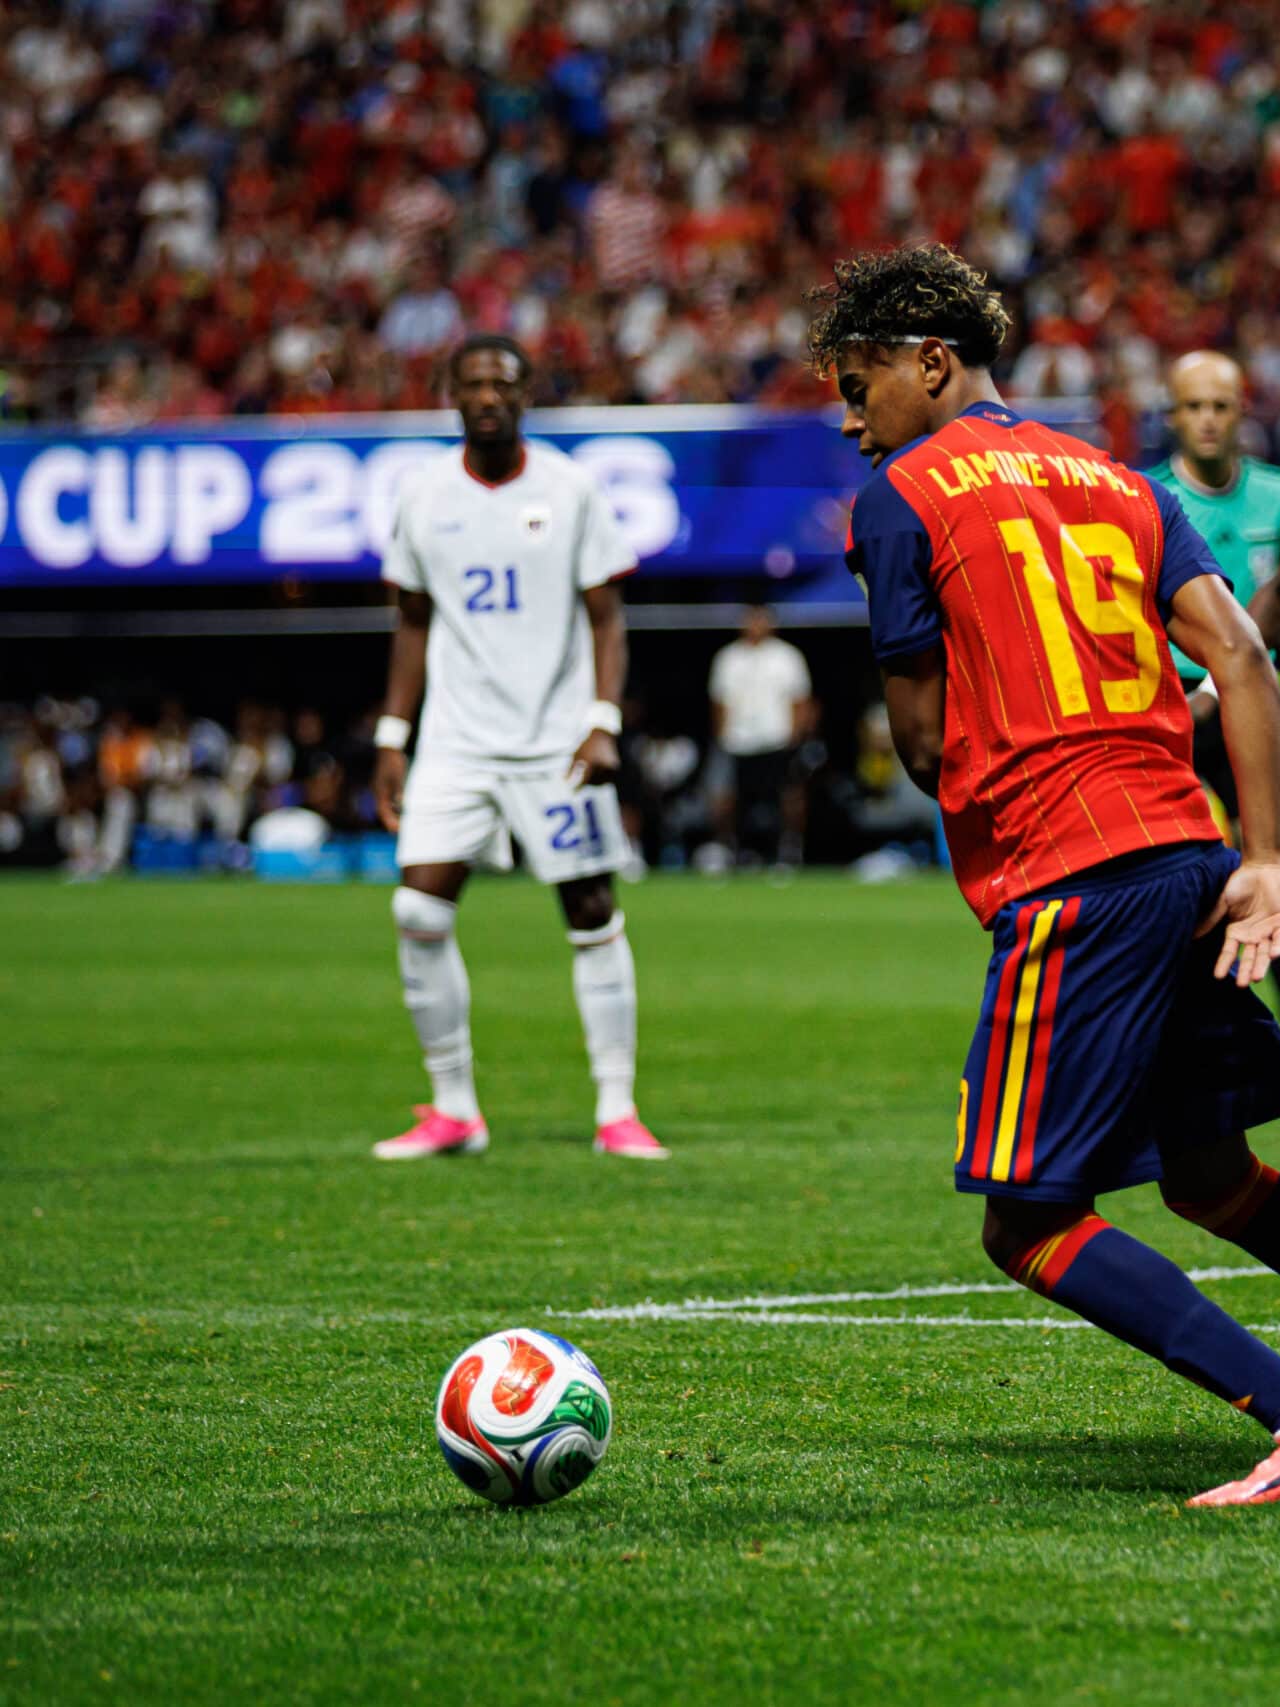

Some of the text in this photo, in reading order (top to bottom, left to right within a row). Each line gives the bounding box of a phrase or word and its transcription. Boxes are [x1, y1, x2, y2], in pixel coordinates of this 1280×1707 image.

[927, 449, 1050, 498] LAMINE
[16, 444, 252, 569] CUP
[465, 566, 519, 612] 21
[997, 518, 1162, 717] 19
[545, 798, 604, 857] 21
